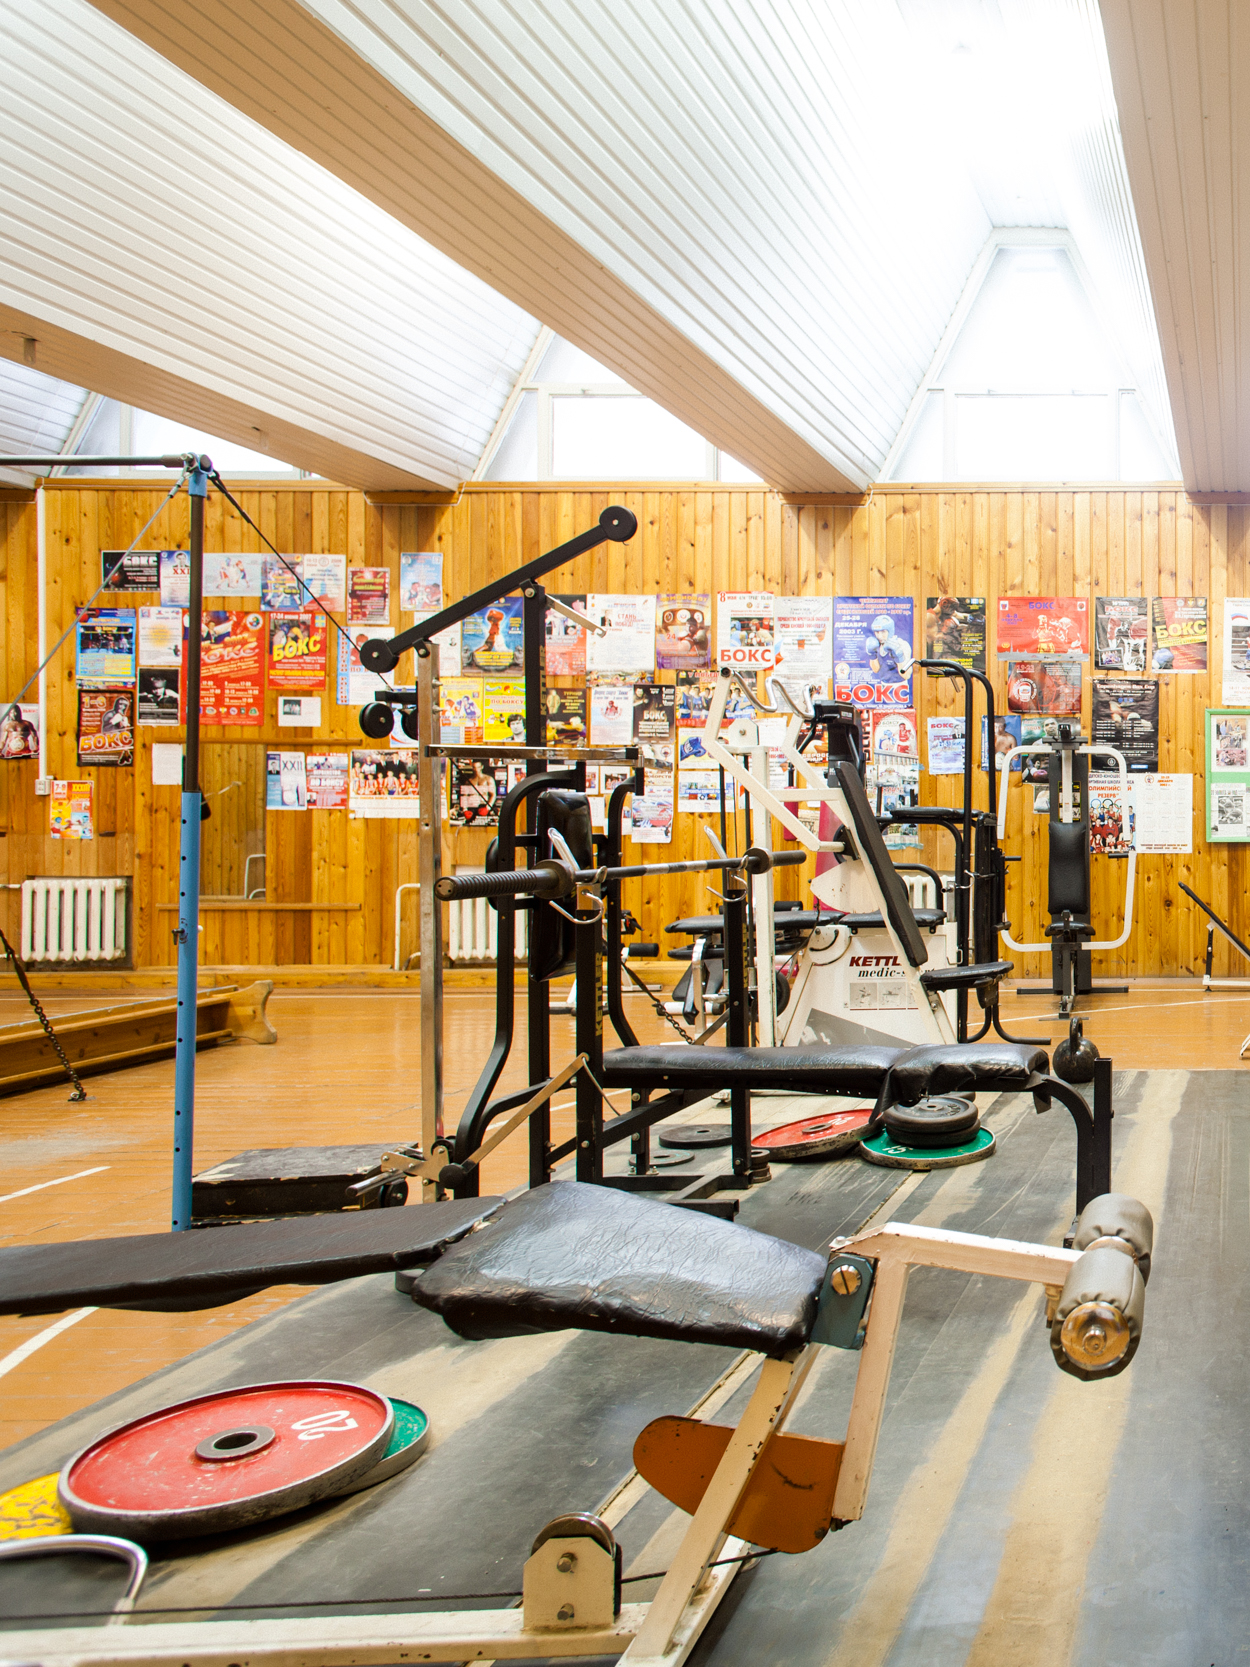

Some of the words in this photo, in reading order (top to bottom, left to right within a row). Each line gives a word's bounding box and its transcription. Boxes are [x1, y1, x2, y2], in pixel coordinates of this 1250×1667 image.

[123, 556, 157, 567] БОКС
[719, 592, 726, 602] 8
[1028, 602, 1055, 610] БОКС
[1155, 620, 1206, 639] БОКС
[201, 642, 259, 663] ОКС
[273, 635, 321, 662] БОКС
[720, 649, 771, 662] БОКС
[835, 684, 909, 703] БОКС
[643, 710, 666, 720] БОКС
[79, 732, 134, 753] БОКС
[849, 956, 902, 967] KETTL
[290, 1409, 360, 1441] 20
